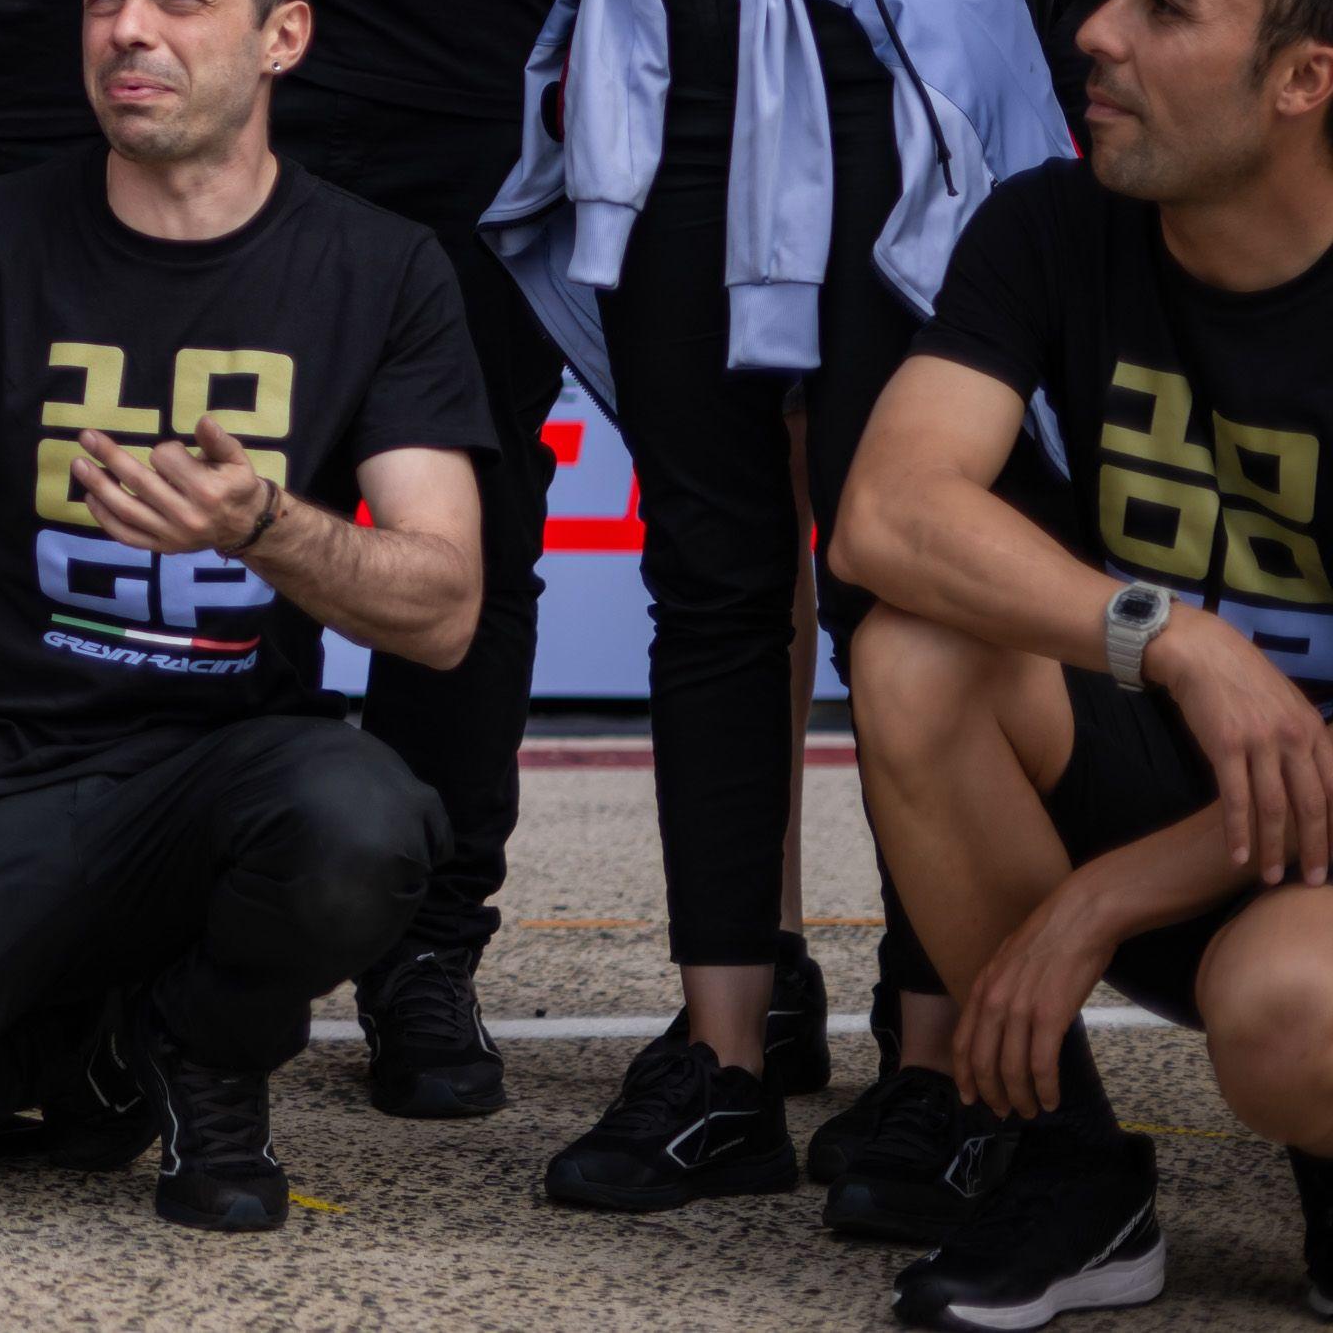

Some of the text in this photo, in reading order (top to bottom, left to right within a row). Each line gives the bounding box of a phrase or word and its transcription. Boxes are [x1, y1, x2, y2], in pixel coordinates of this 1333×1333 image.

[42, 342, 294, 438] 10
[35, 438, 287, 528] 0
[36, 528, 276, 628] GP
[1106, 561, 1333, 683] P
[43, 631, 147, 666] GRESINI
